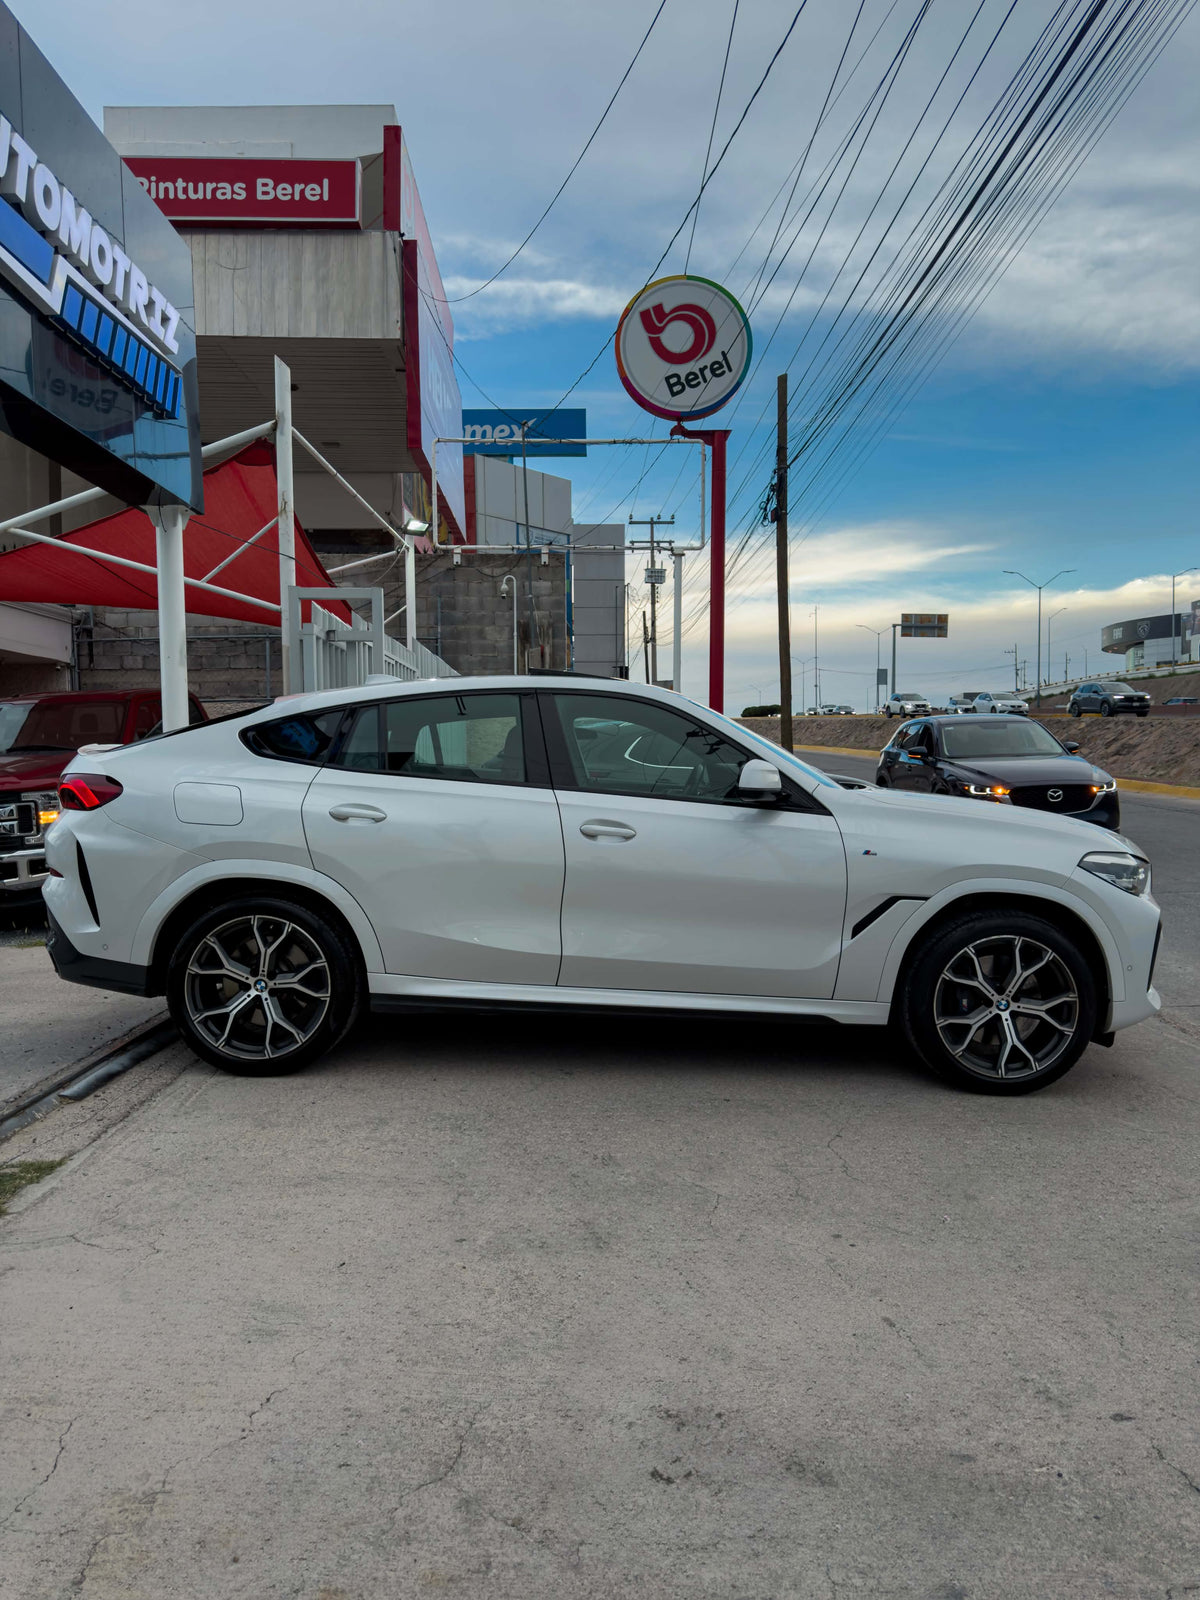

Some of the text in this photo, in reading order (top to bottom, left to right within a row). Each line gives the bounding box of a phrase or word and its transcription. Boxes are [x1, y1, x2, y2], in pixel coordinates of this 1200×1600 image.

[256, 178, 329, 201] Berel
[664, 350, 733, 398] Berel
[462, 418, 537, 446] mex
